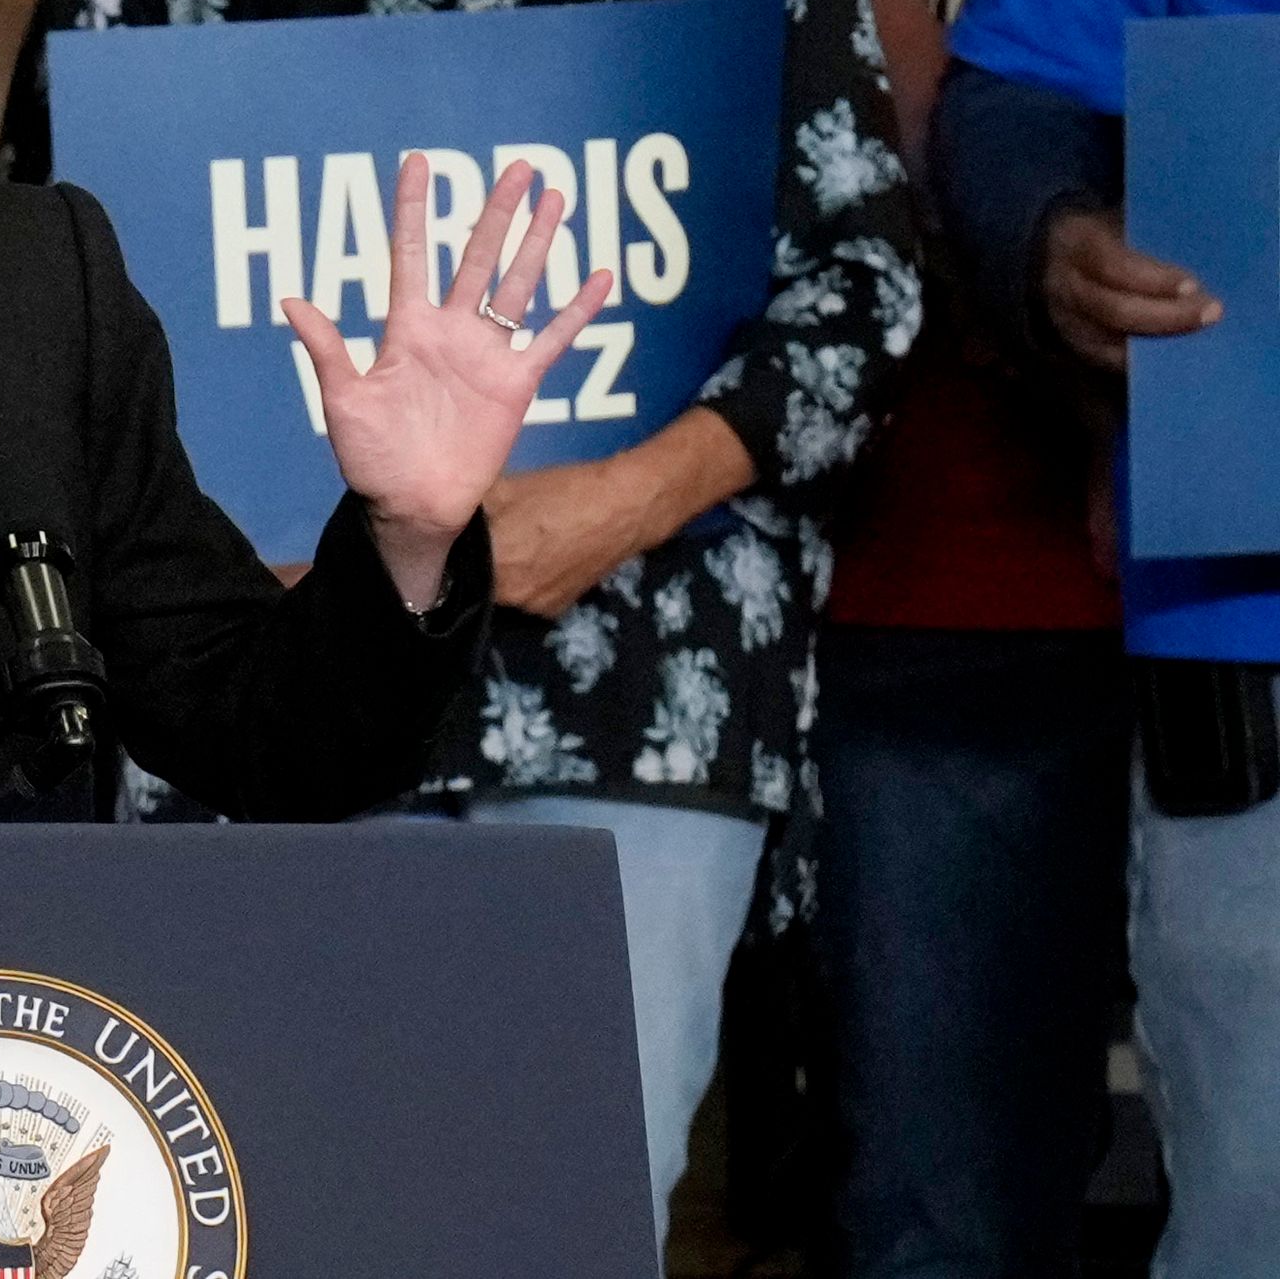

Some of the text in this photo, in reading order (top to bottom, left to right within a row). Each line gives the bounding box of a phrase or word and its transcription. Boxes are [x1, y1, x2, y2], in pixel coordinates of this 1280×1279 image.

[210, 133, 690, 328] HARRIS
[9, 1160, 48, 1175] UNUM
[94, 1017, 230, 1226] UNITED
